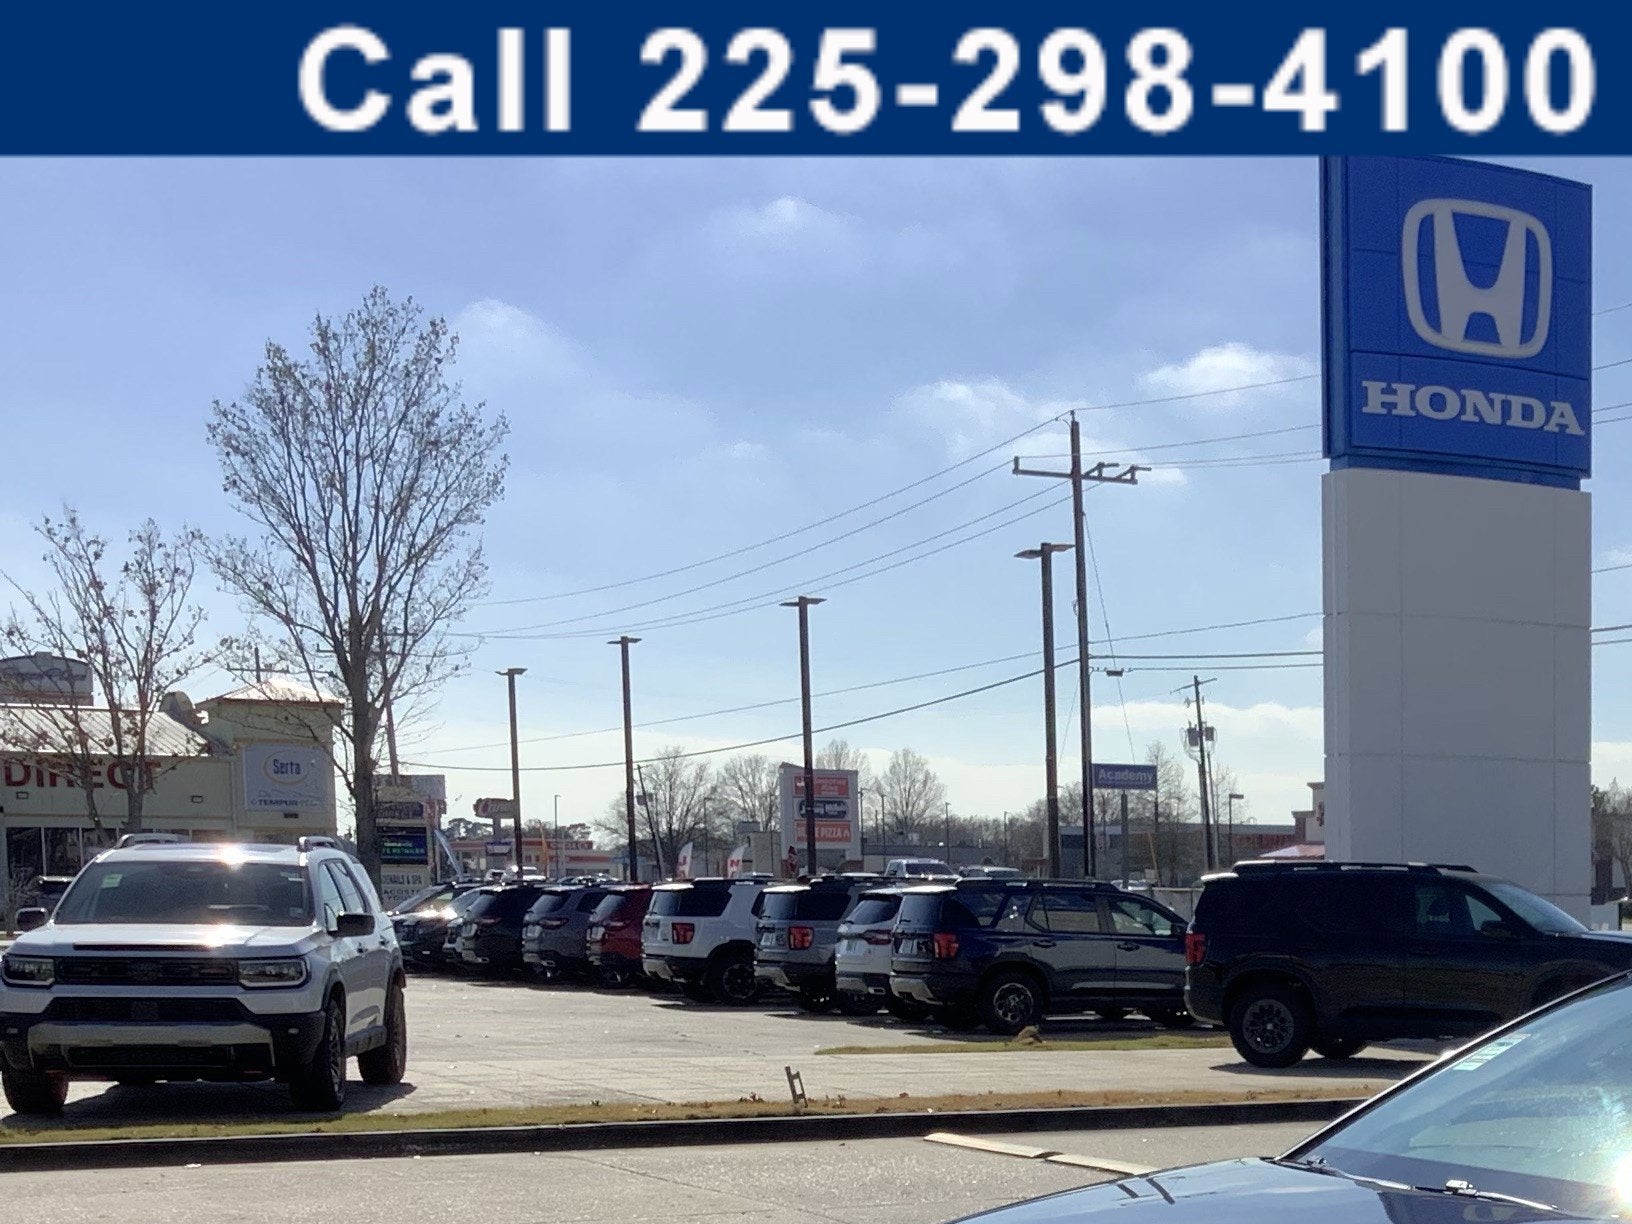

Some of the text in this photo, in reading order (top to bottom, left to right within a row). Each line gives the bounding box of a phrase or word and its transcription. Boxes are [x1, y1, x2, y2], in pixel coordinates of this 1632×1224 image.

[1362, 380, 1585, 436] HONDA
[273, 759, 301, 775] Serta
[1098, 768, 1154, 784] Academy
